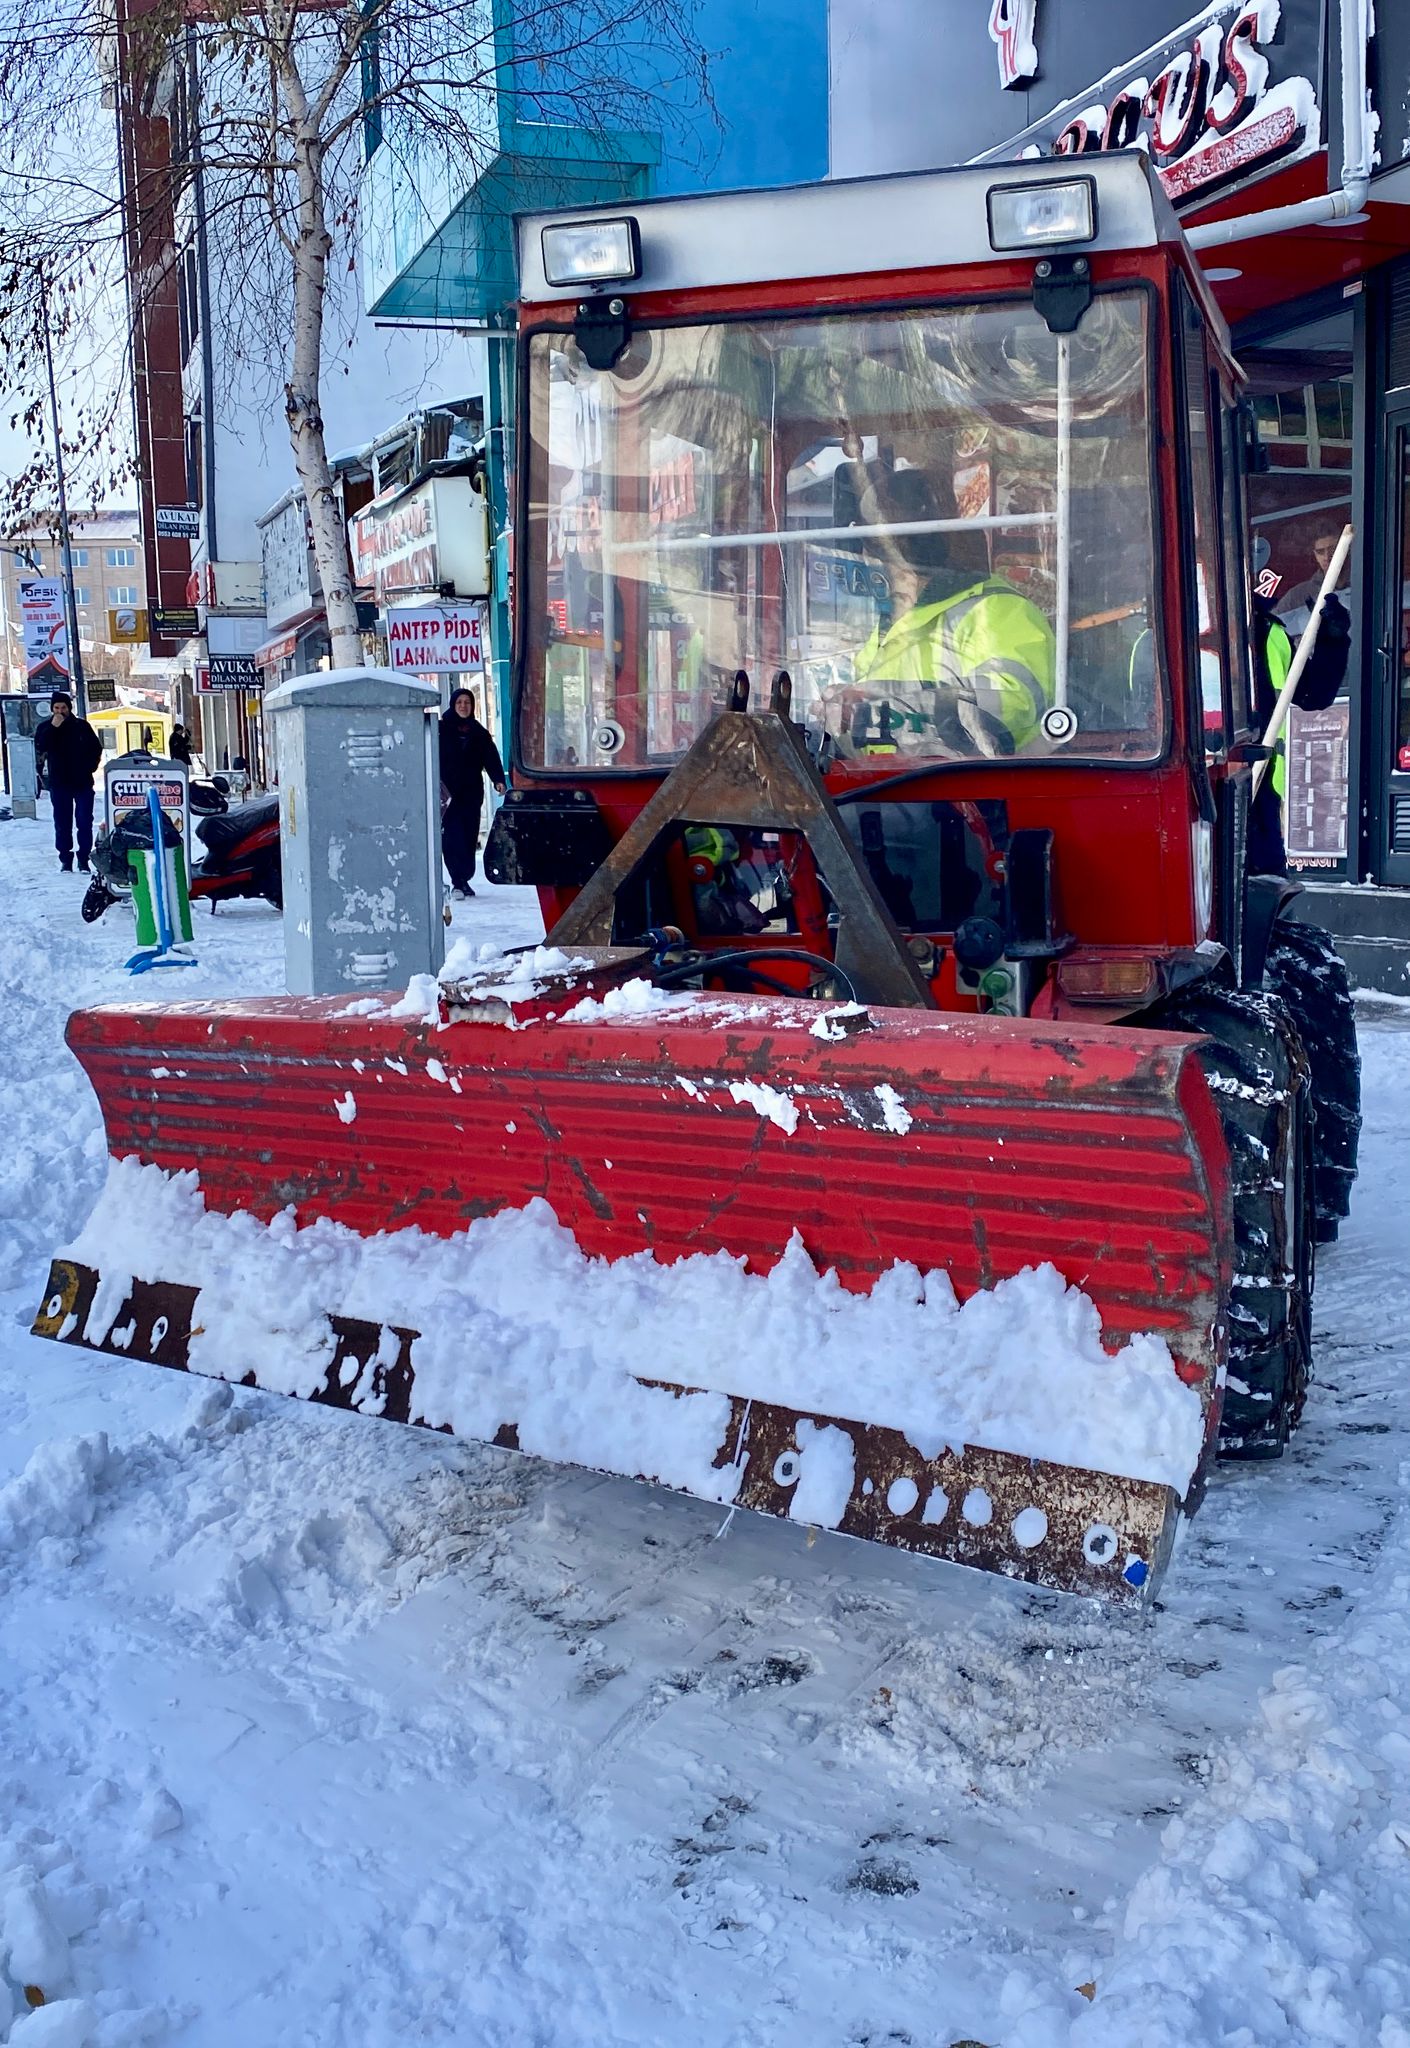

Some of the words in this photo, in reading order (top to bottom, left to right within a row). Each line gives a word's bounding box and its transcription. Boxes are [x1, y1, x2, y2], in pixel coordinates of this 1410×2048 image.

[157, 511, 198, 523] AVUKAT
[389, 620, 441, 640] ANTEP
[443, 613, 480, 640] PİDE
[211, 674, 237, 683] DİLAN
[238, 675, 264, 684] POLAT
